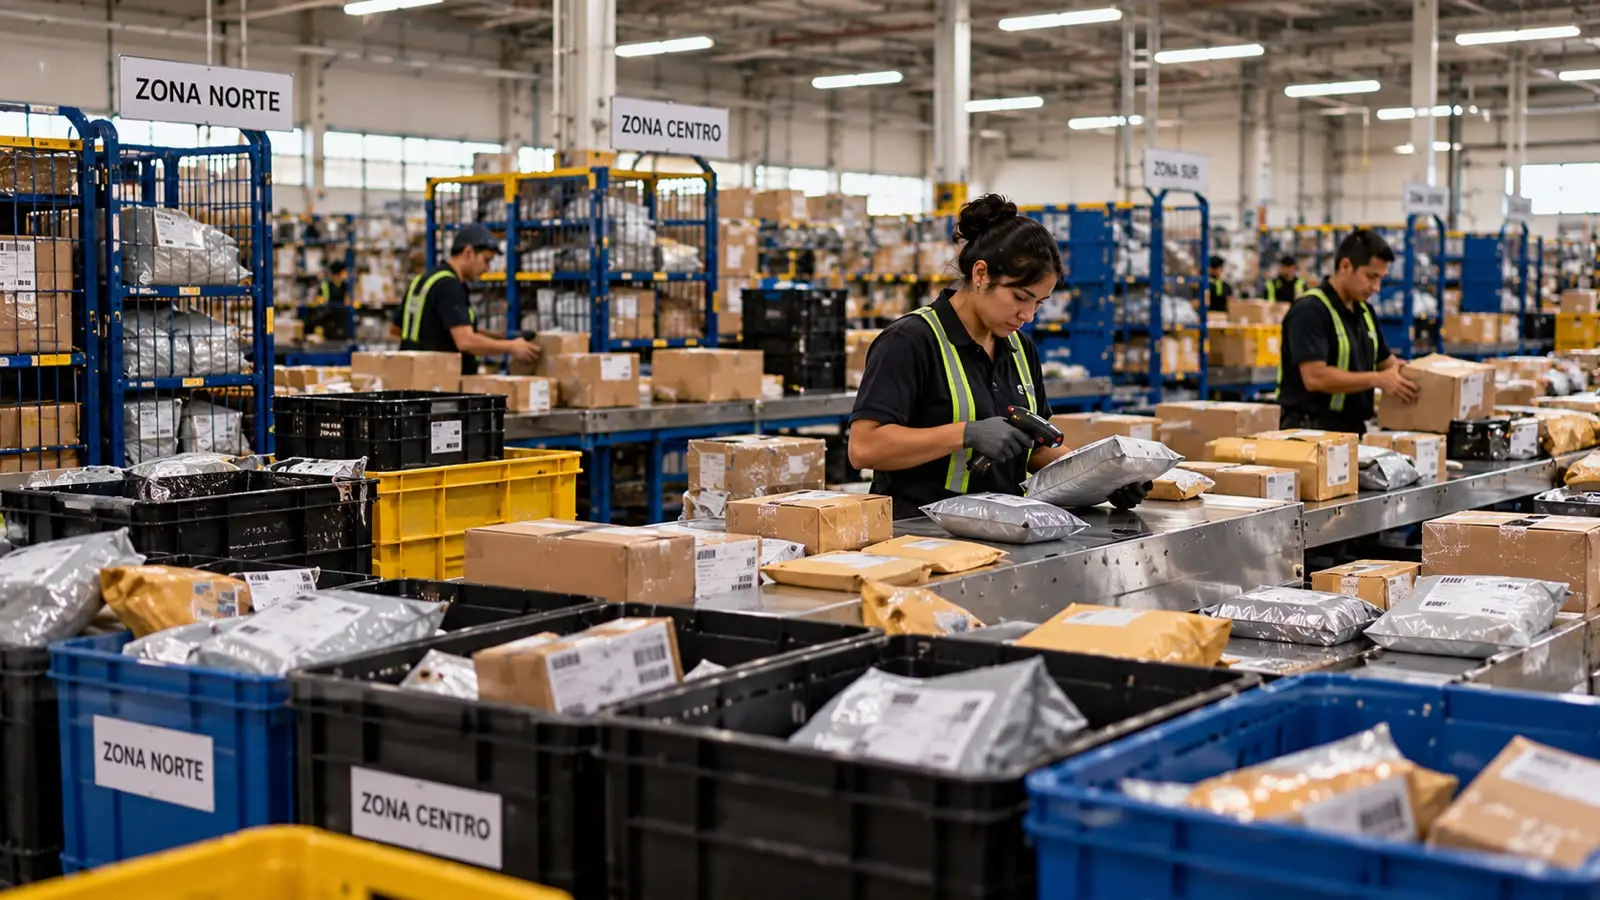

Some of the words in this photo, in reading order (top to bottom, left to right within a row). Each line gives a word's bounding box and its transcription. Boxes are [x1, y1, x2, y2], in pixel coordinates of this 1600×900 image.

[135, 77, 201, 105] ZONA
[209, 84, 280, 113] NORTE
[621, 114, 663, 137] ZONA
[666, 119, 722, 142] CENTRO
[103, 740, 146, 769] ZONA
[151, 751, 204, 782] NORTE
[361, 791, 411, 823] ZONA
[416, 804, 491, 841] CENTRO
